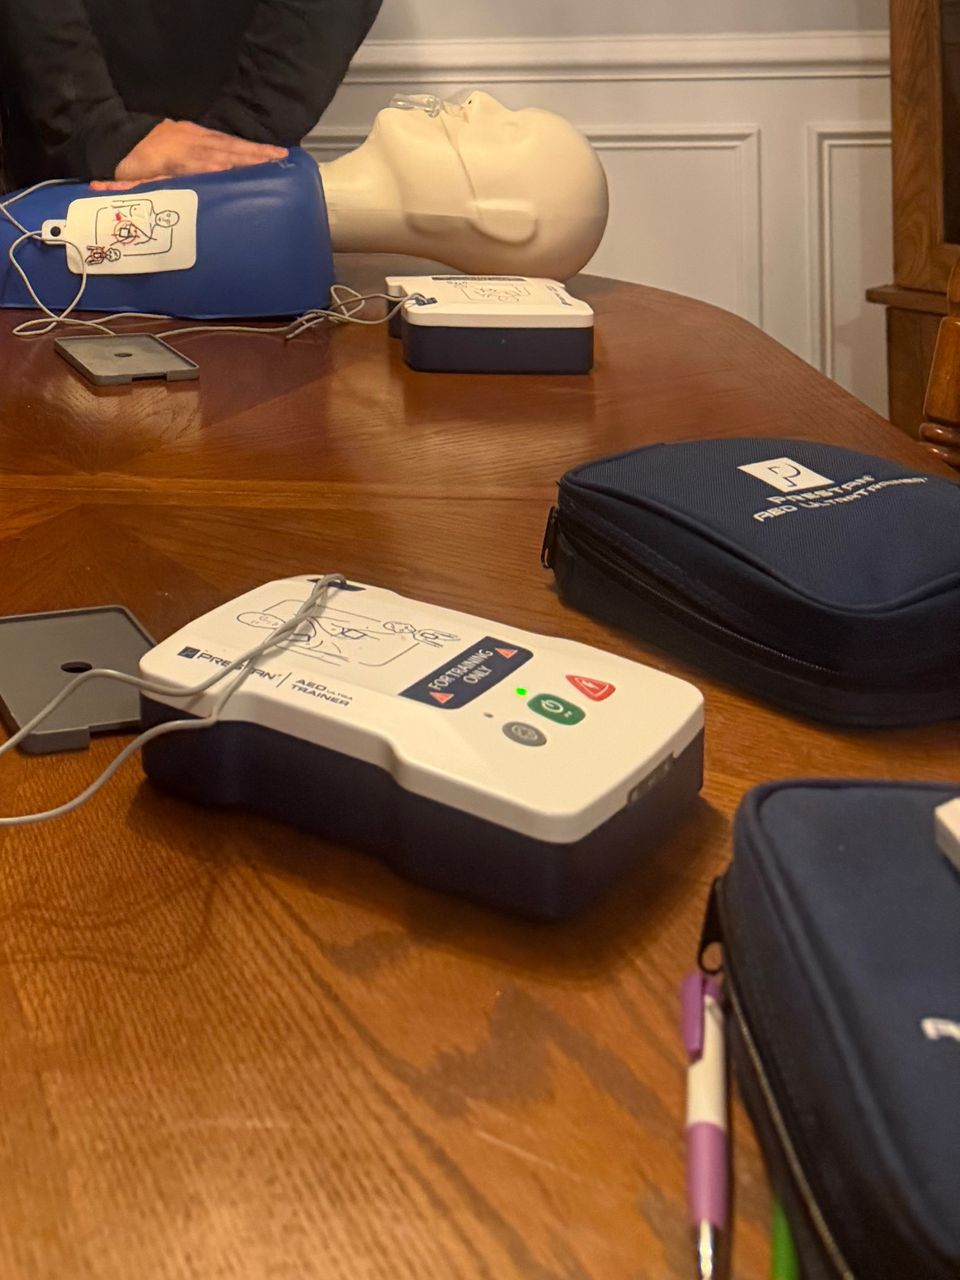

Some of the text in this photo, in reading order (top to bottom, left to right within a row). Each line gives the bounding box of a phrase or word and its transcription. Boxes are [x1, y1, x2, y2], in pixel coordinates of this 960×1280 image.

[753, 504, 798, 522] AED
[197, 652, 278, 680] PREAN
[428, 649, 494, 690] FOR TRAINING
[463, 664, 493, 684] ONLY
[291, 684, 351, 707] TRAINER
[295, 679, 327, 692] AED
